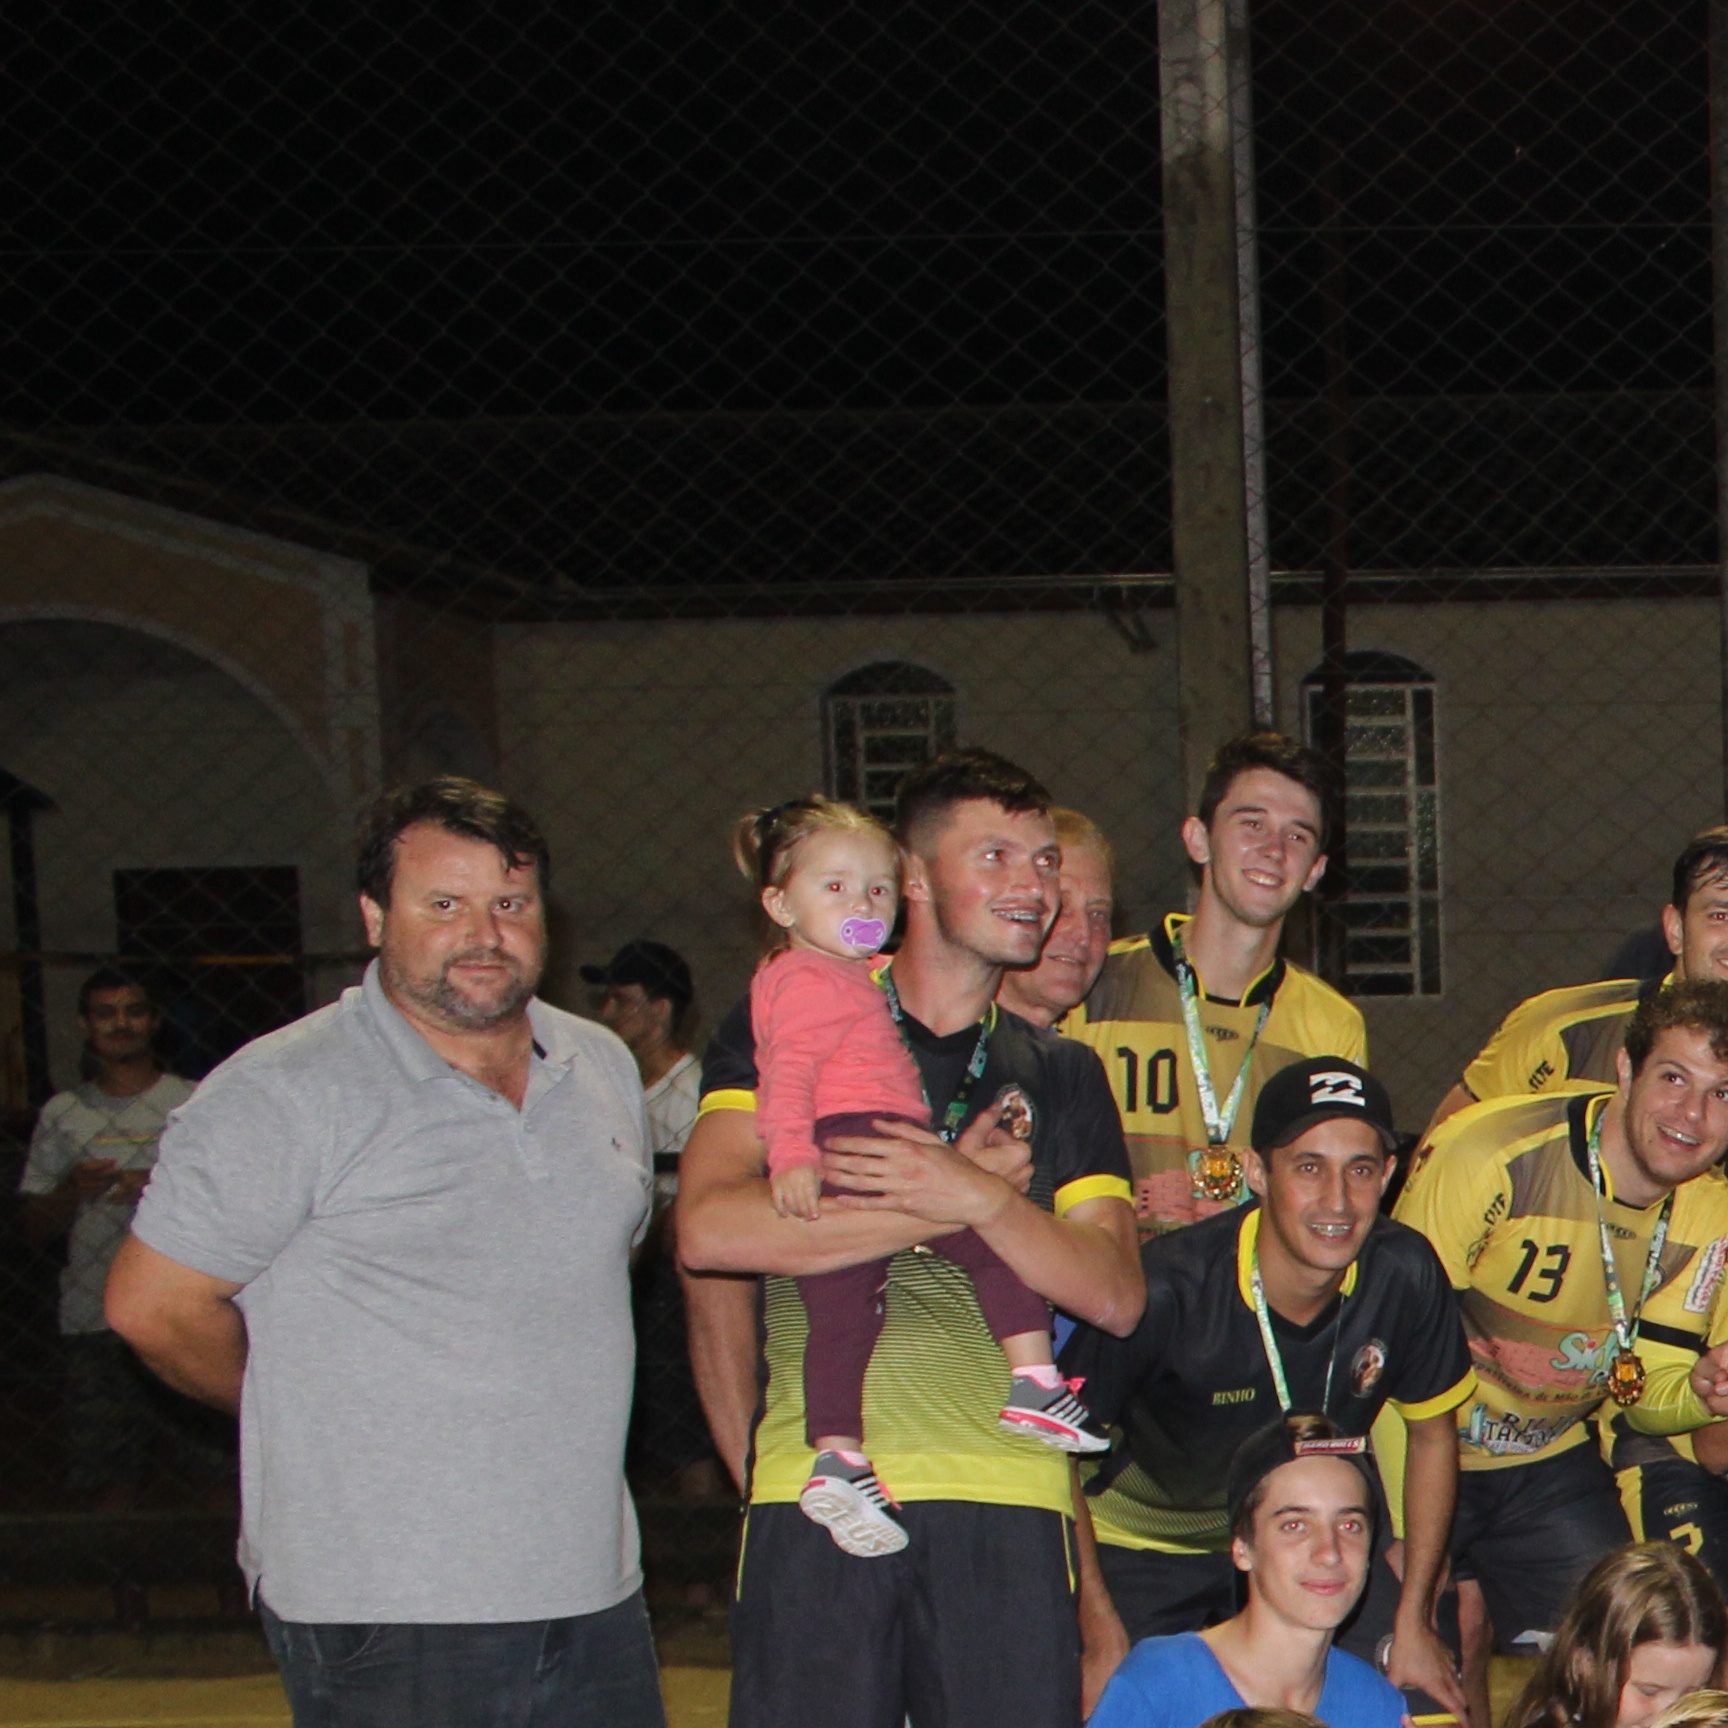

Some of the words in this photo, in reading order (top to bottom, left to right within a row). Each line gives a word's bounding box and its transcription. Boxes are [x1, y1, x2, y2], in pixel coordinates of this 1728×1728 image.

[1115, 1046, 1179, 1115] 10
[1507, 1239, 1571, 1303] 13
[1211, 1386, 1257, 1406] BINHO
